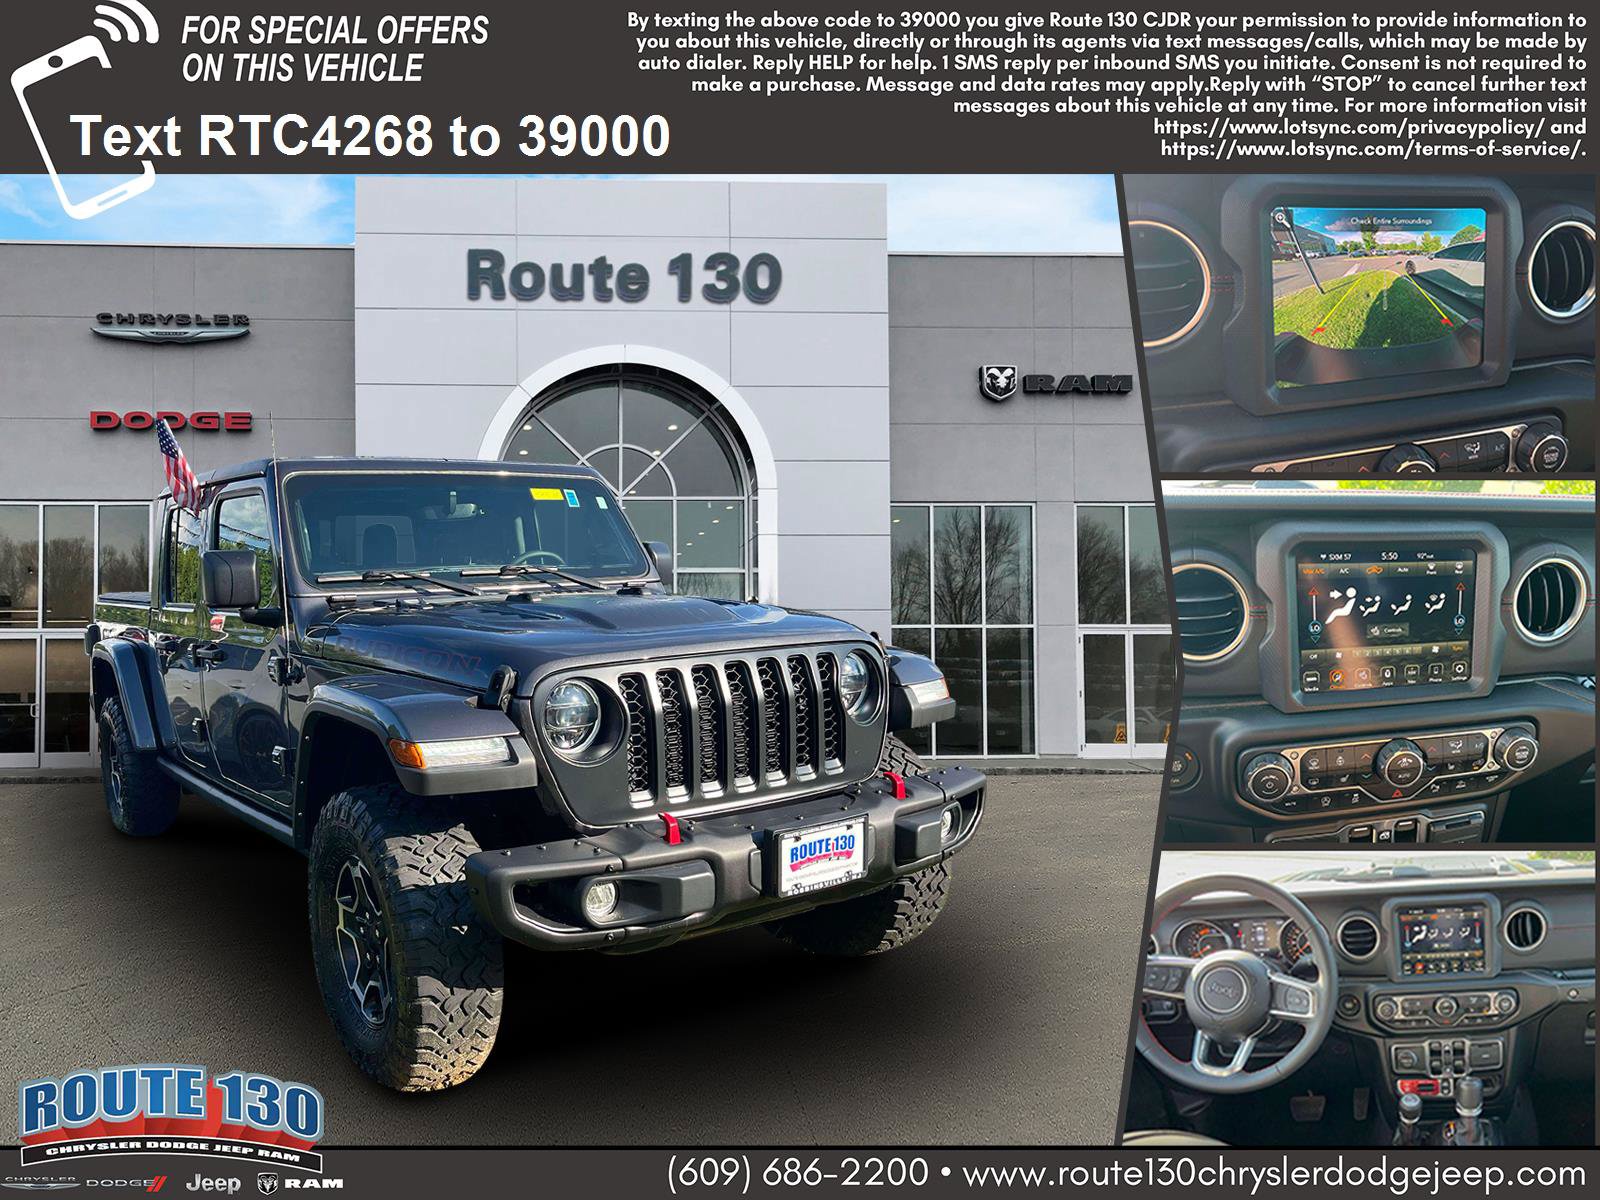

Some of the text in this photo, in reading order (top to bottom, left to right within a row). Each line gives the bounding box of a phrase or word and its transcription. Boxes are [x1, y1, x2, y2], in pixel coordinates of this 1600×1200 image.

[1350, 216, 1432, 225] Check Entire Surroundings
[467, 248, 783, 304] Route 130
[96, 312, 250, 326] CHRYSLER
[1023, 374, 1133, 394] RAM
[89, 411, 252, 430] DODGE
[1381, 551, 1399, 560] 5:50
[336, 635, 482, 676] RUBICON
[790, 837, 832, 863] ROUTE
[834, 835, 855, 851] 130
